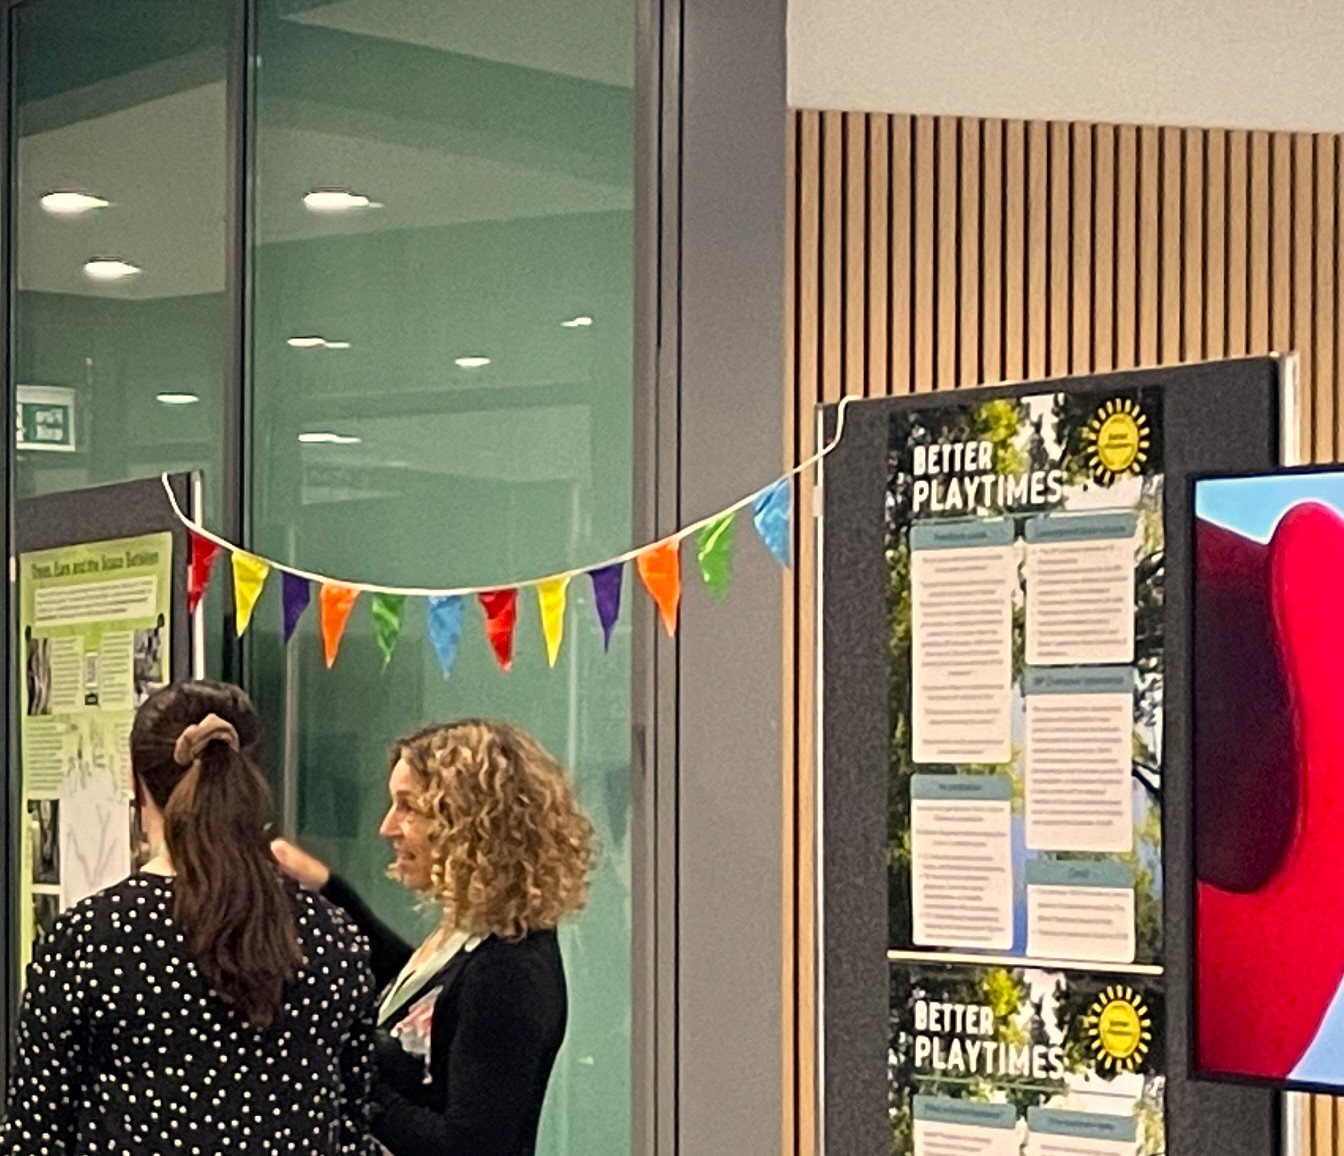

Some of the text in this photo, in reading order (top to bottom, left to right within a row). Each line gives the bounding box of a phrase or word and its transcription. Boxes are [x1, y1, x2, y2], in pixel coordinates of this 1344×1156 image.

[912, 440, 993, 476] BETTER
[912, 469, 1064, 513] PLAYTIMES
[914, 1000, 994, 1036] BETTER
[914, 1036, 1065, 1079] PLAYTIMES
